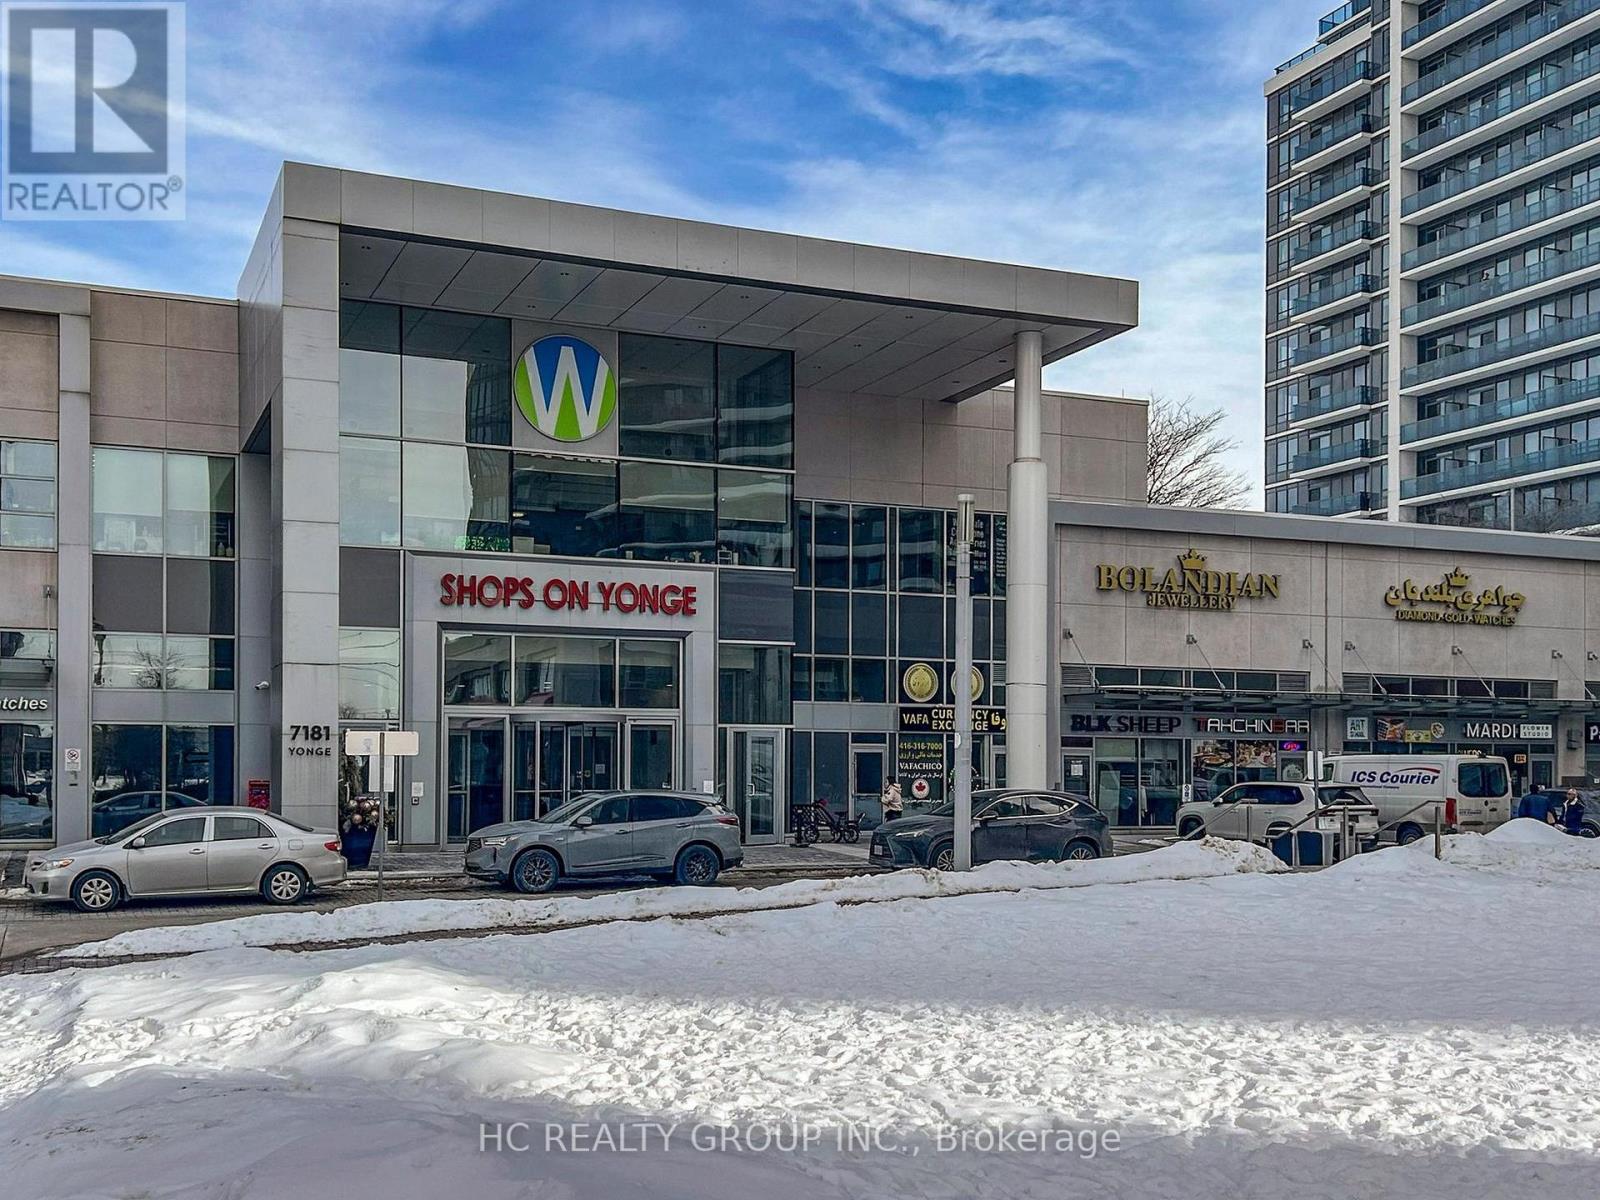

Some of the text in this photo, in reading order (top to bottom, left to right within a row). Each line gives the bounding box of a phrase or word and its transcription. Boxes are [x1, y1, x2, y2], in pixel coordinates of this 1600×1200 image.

[523, 346, 610, 439] W
[1096, 564, 1281, 598] BOLANDIAN
[440, 573, 697, 615] SHOPS ON YONGE
[1147, 592, 1237, 610] JEWELLERY
[0, 696, 48, 710] tches
[902, 713, 929, 725] VAFA
[931, 709, 989, 719] CURCY
[931, 720, 989, 731] EXCGE
[1070, 714, 1182, 733] BLK SHEEP
[1466, 723, 1516, 738] MARDI
[290, 725, 330, 741] 7181
[1589, 725, 1600, 741] P
[288, 747, 331, 756] YONGE
[899, 762, 943, 770] VAFACHICO
[1350, 771, 1440, 785] ICS Courier
